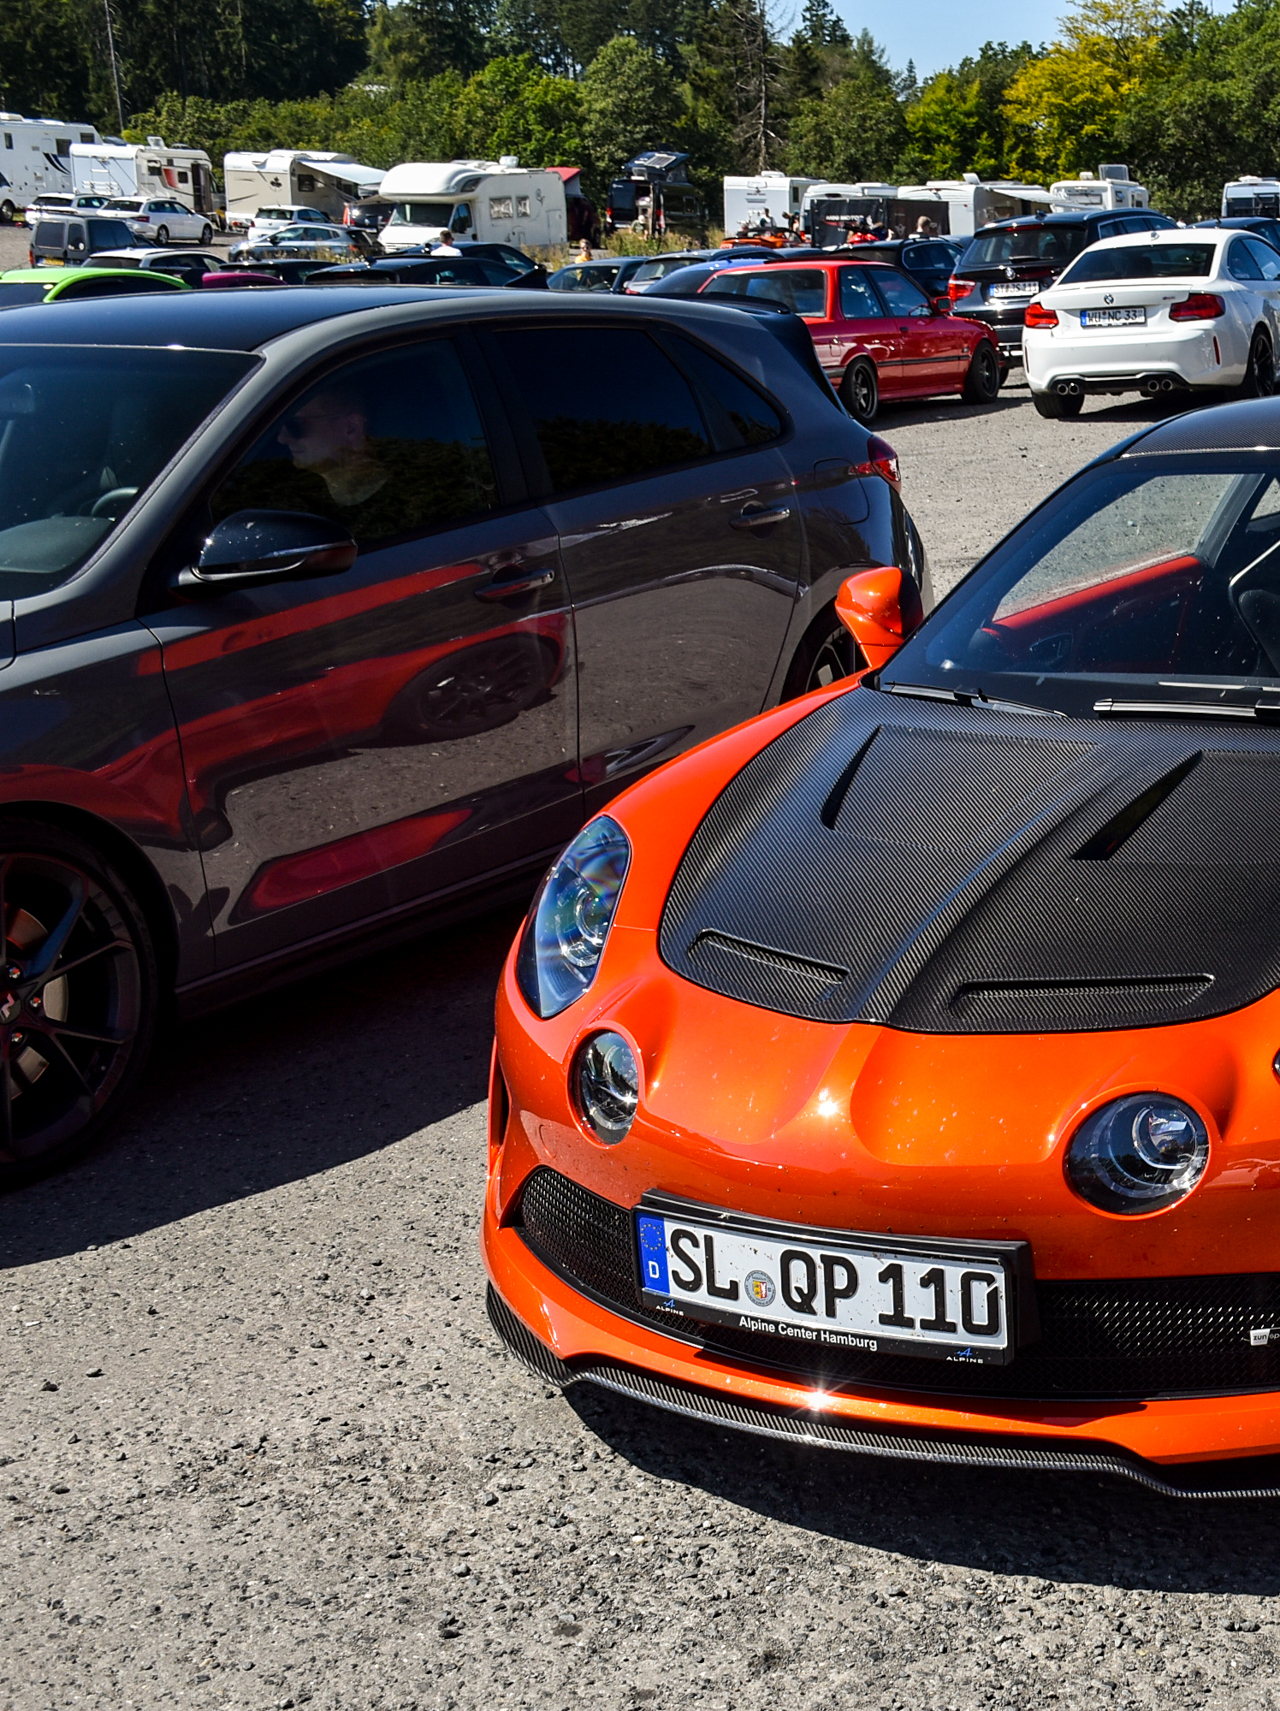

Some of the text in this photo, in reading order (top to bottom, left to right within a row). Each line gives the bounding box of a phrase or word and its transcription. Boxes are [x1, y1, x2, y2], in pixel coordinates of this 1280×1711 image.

[1107, 310, 1121, 322] NC
[1124, 309, 1137, 321] 33
[649, 1260, 660, 1279] D
[670, 1228, 740, 1301] SL
[779, 1248, 859, 1319] QP
[878, 1262, 1000, 1337] 110
[655, 1305, 684, 1317] ALPINE
[739, 1316, 878, 1352] Alpine Center Hamburg
[946, 1356, 984, 1364] ALPINE
